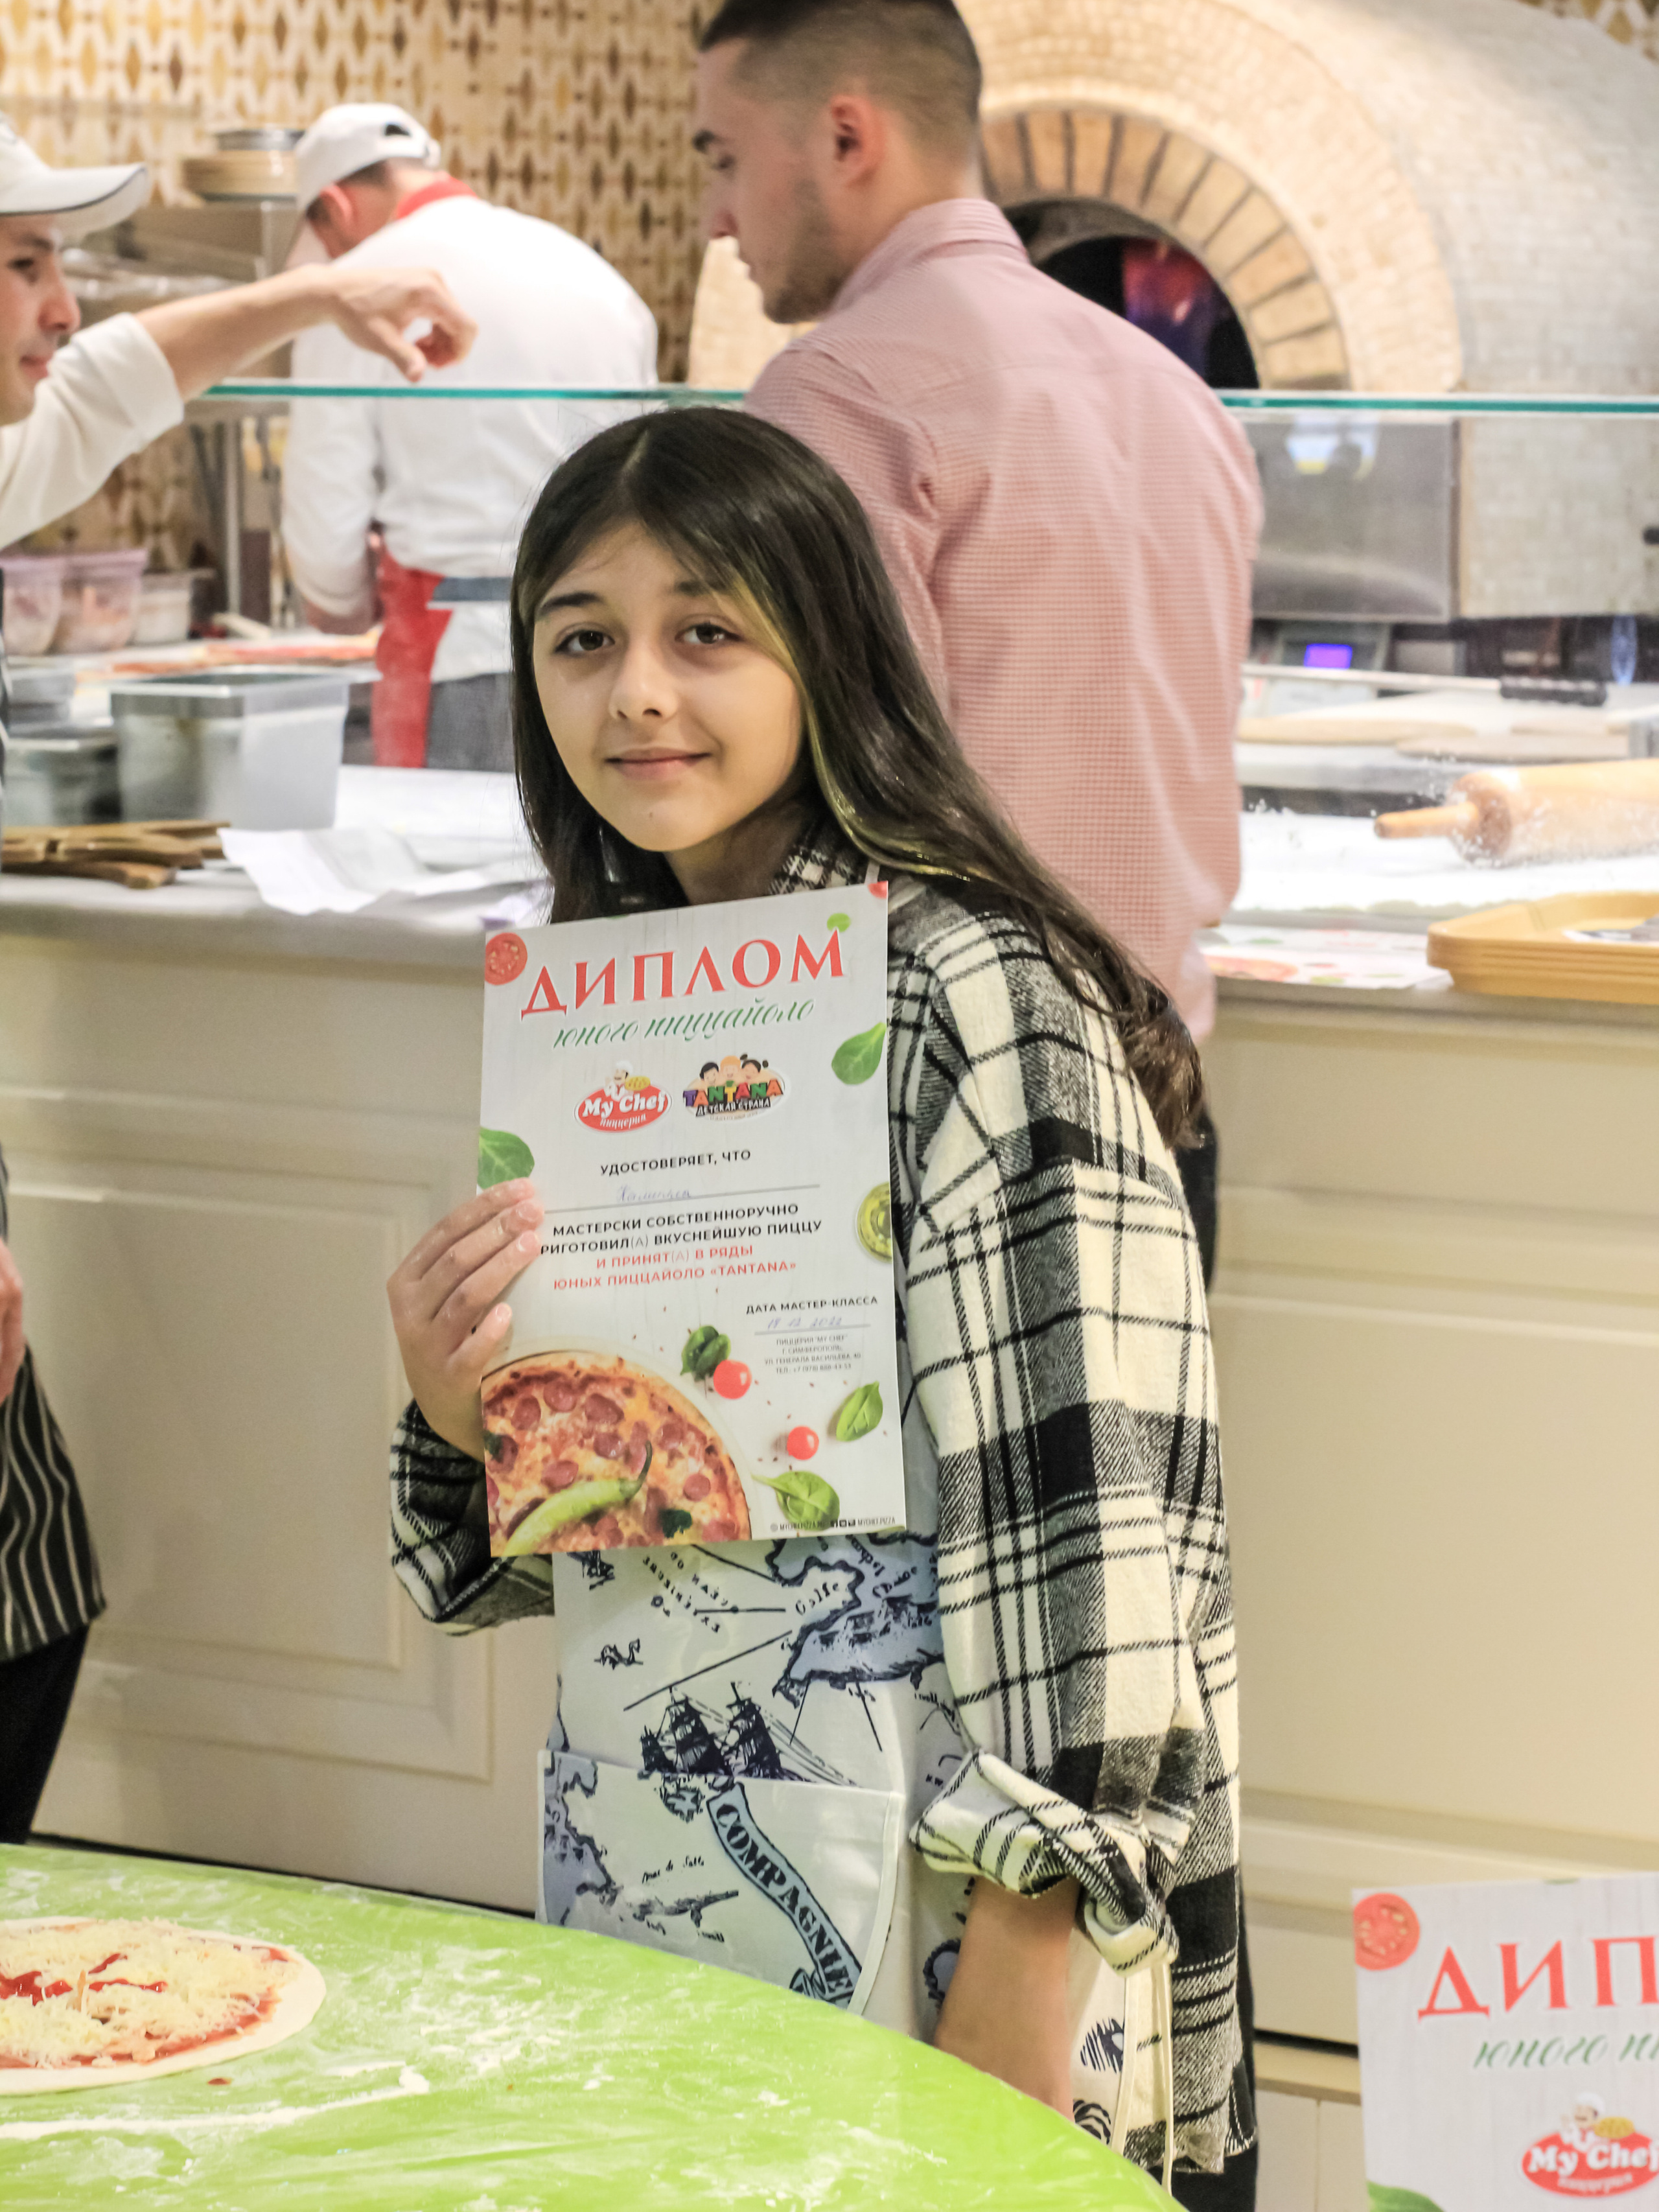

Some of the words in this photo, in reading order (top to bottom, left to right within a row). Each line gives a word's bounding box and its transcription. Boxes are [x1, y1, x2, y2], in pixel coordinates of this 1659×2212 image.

[520, 928, 844, 1021] ДИПЛОМ
[553, 1020, 639, 1049] юного
[644, 997, 815, 1041] пиццайоло
[582, 1098, 614, 1119] My
[619, 1090, 668, 1113] Chef
[682, 1078, 784, 1108] TANTANA
[737, 1097, 771, 1112] СТРАНА
[600, 1152, 717, 1177] УДОСТОВЕРЯЕТ,
[722, 1148, 751, 1163] ЧТО
[553, 1218, 642, 1237] МАСТЕРСКИ
[646, 1203, 799, 1229] СОБСТВЕННОРУЧНО
[540, 1235, 649, 1255] РИГОТОВИЛ(А)
[653, 1224, 762, 1246] ВКУСНЕЙШУЮ
[767, 1219, 822, 1237] ПИЦЦУ
[596, 1257, 606, 1269] И
[611, 1248, 690, 1268] ПРИНЯТ(А)
[695, 1248, 704, 1260] В
[709, 1244, 753, 1259] РЯДЫ
[553, 1275, 601, 1290] ЮНЫХ
[607, 1266, 705, 1286] ПИЦЦАЙОЛО
[746, 1303, 777, 1316] ДАТА
[776, 1335, 814, 1347] ПИЦЦЕРИЯ
[776, 1355, 810, 1365] ГЕНЕРАЛА
[715, 1803, 854, 1994] COMPAGNIE
[1472, 2034, 1608, 2069] юного
[1527, 2145, 1579, 2178] My
